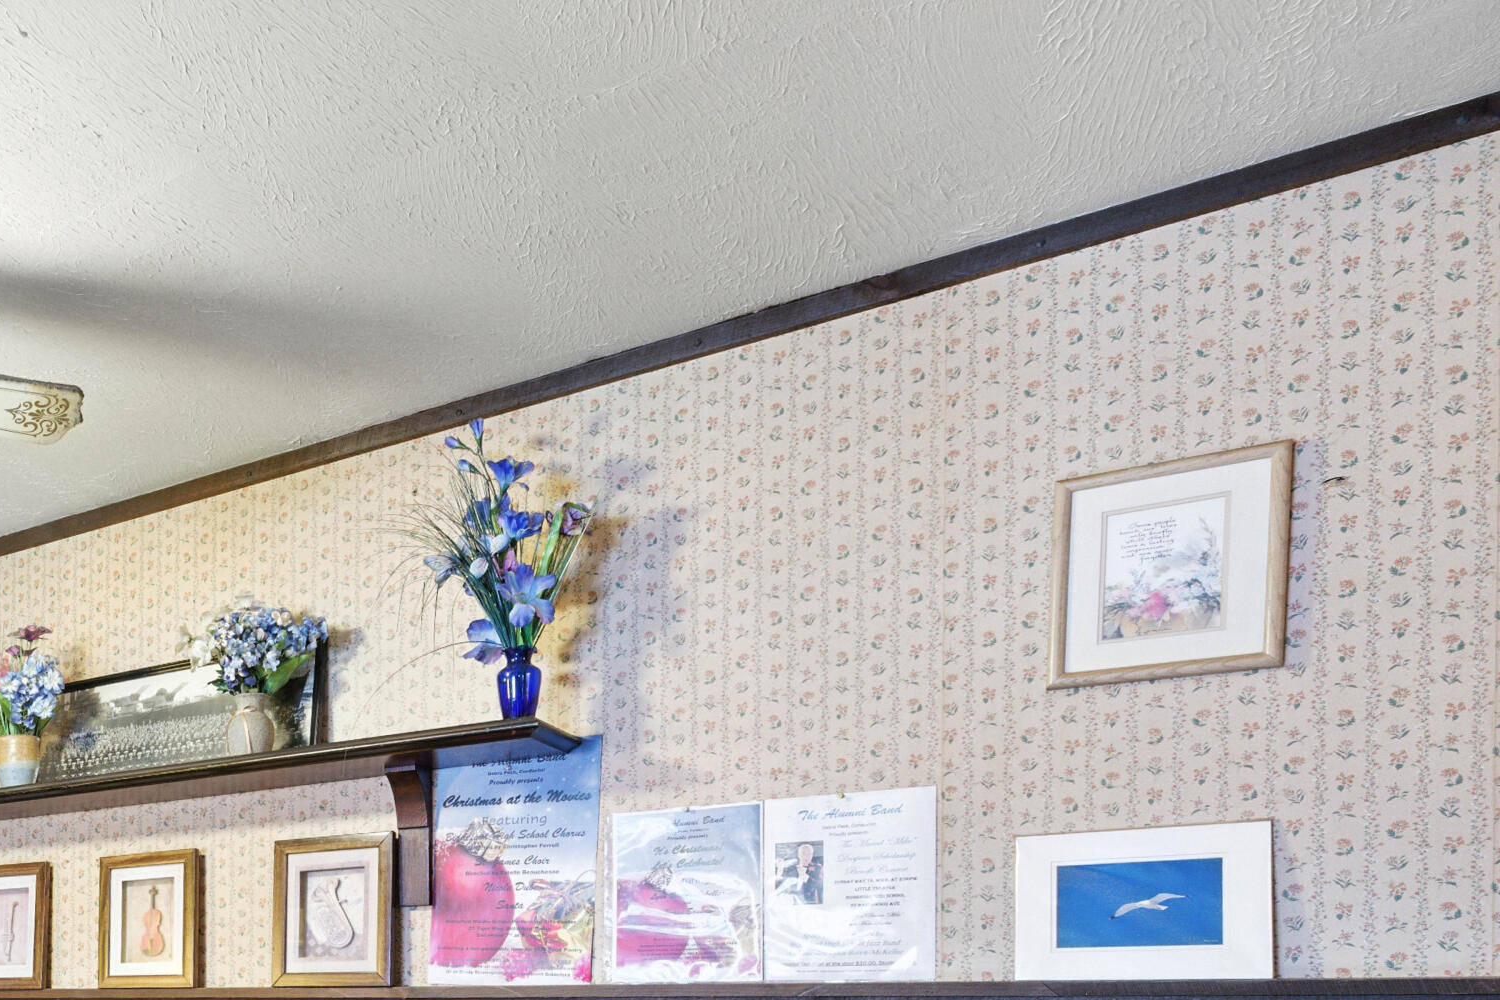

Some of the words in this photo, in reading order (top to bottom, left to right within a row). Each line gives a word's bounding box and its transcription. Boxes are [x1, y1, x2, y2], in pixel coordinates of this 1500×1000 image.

[442, 795, 502, 809] Christmas
[506, 795, 521, 805] at
[522, 791, 542, 804] the
[547, 789, 593, 803] Movies
[797, 809, 820, 821] The
[821, 807, 867, 819] Alumni
[870, 803, 904, 816] Band
[482, 815, 547, 827] Featuring
[517, 830, 548, 840] School
[551, 827, 586, 839] Chorus
[523, 855, 551, 866] Choir
[495, 900, 524, 910] Santa
